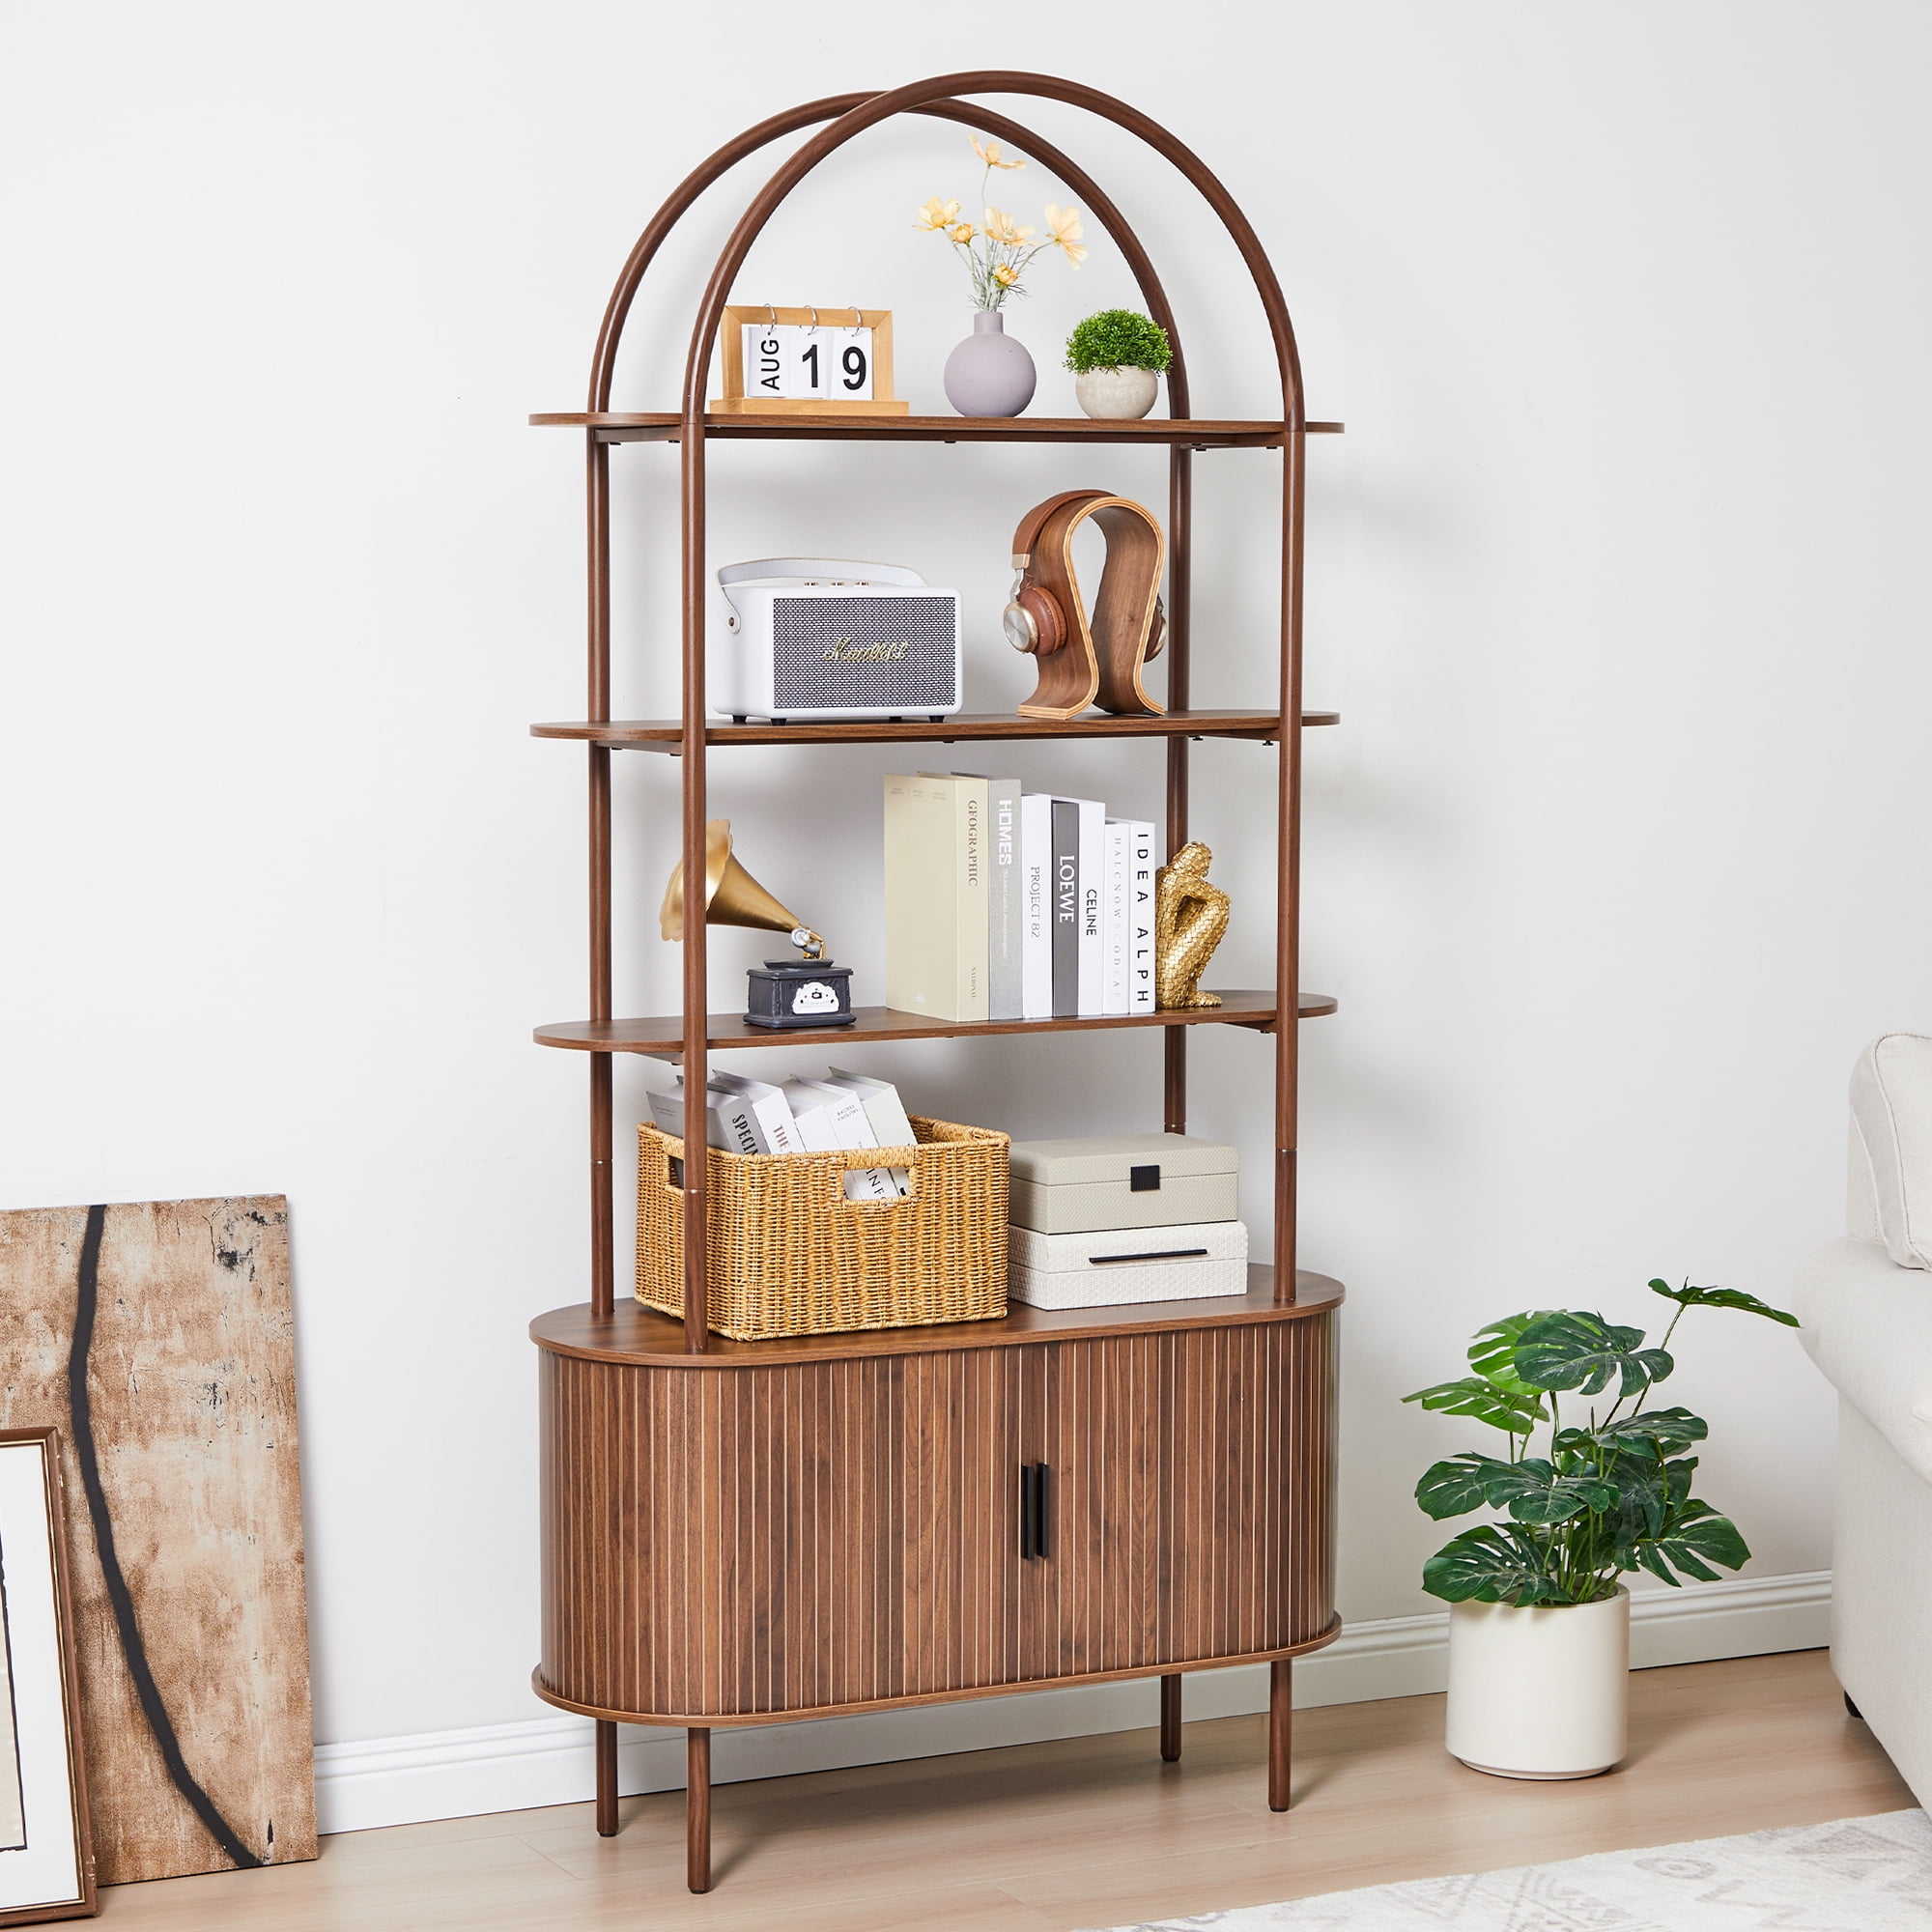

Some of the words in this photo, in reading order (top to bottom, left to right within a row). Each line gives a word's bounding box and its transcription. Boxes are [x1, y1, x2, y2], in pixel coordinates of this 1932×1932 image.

[761, 339, 780, 391] AUG
[968, 799, 979, 887] GEOGRAPHIC
[998, 799, 1012, 866] HOMES
[1030, 866, 1041, 920] PROJECT
[1059, 855, 1075, 923] LOEWE
[1137, 834, 1150, 903] IDEA
[1031, 922, 1041, 939] 82
[1086, 889, 1097, 936] CELINE
[1137, 927, 1150, 1002] ALPH
[773, 1122, 790, 1151] THE
